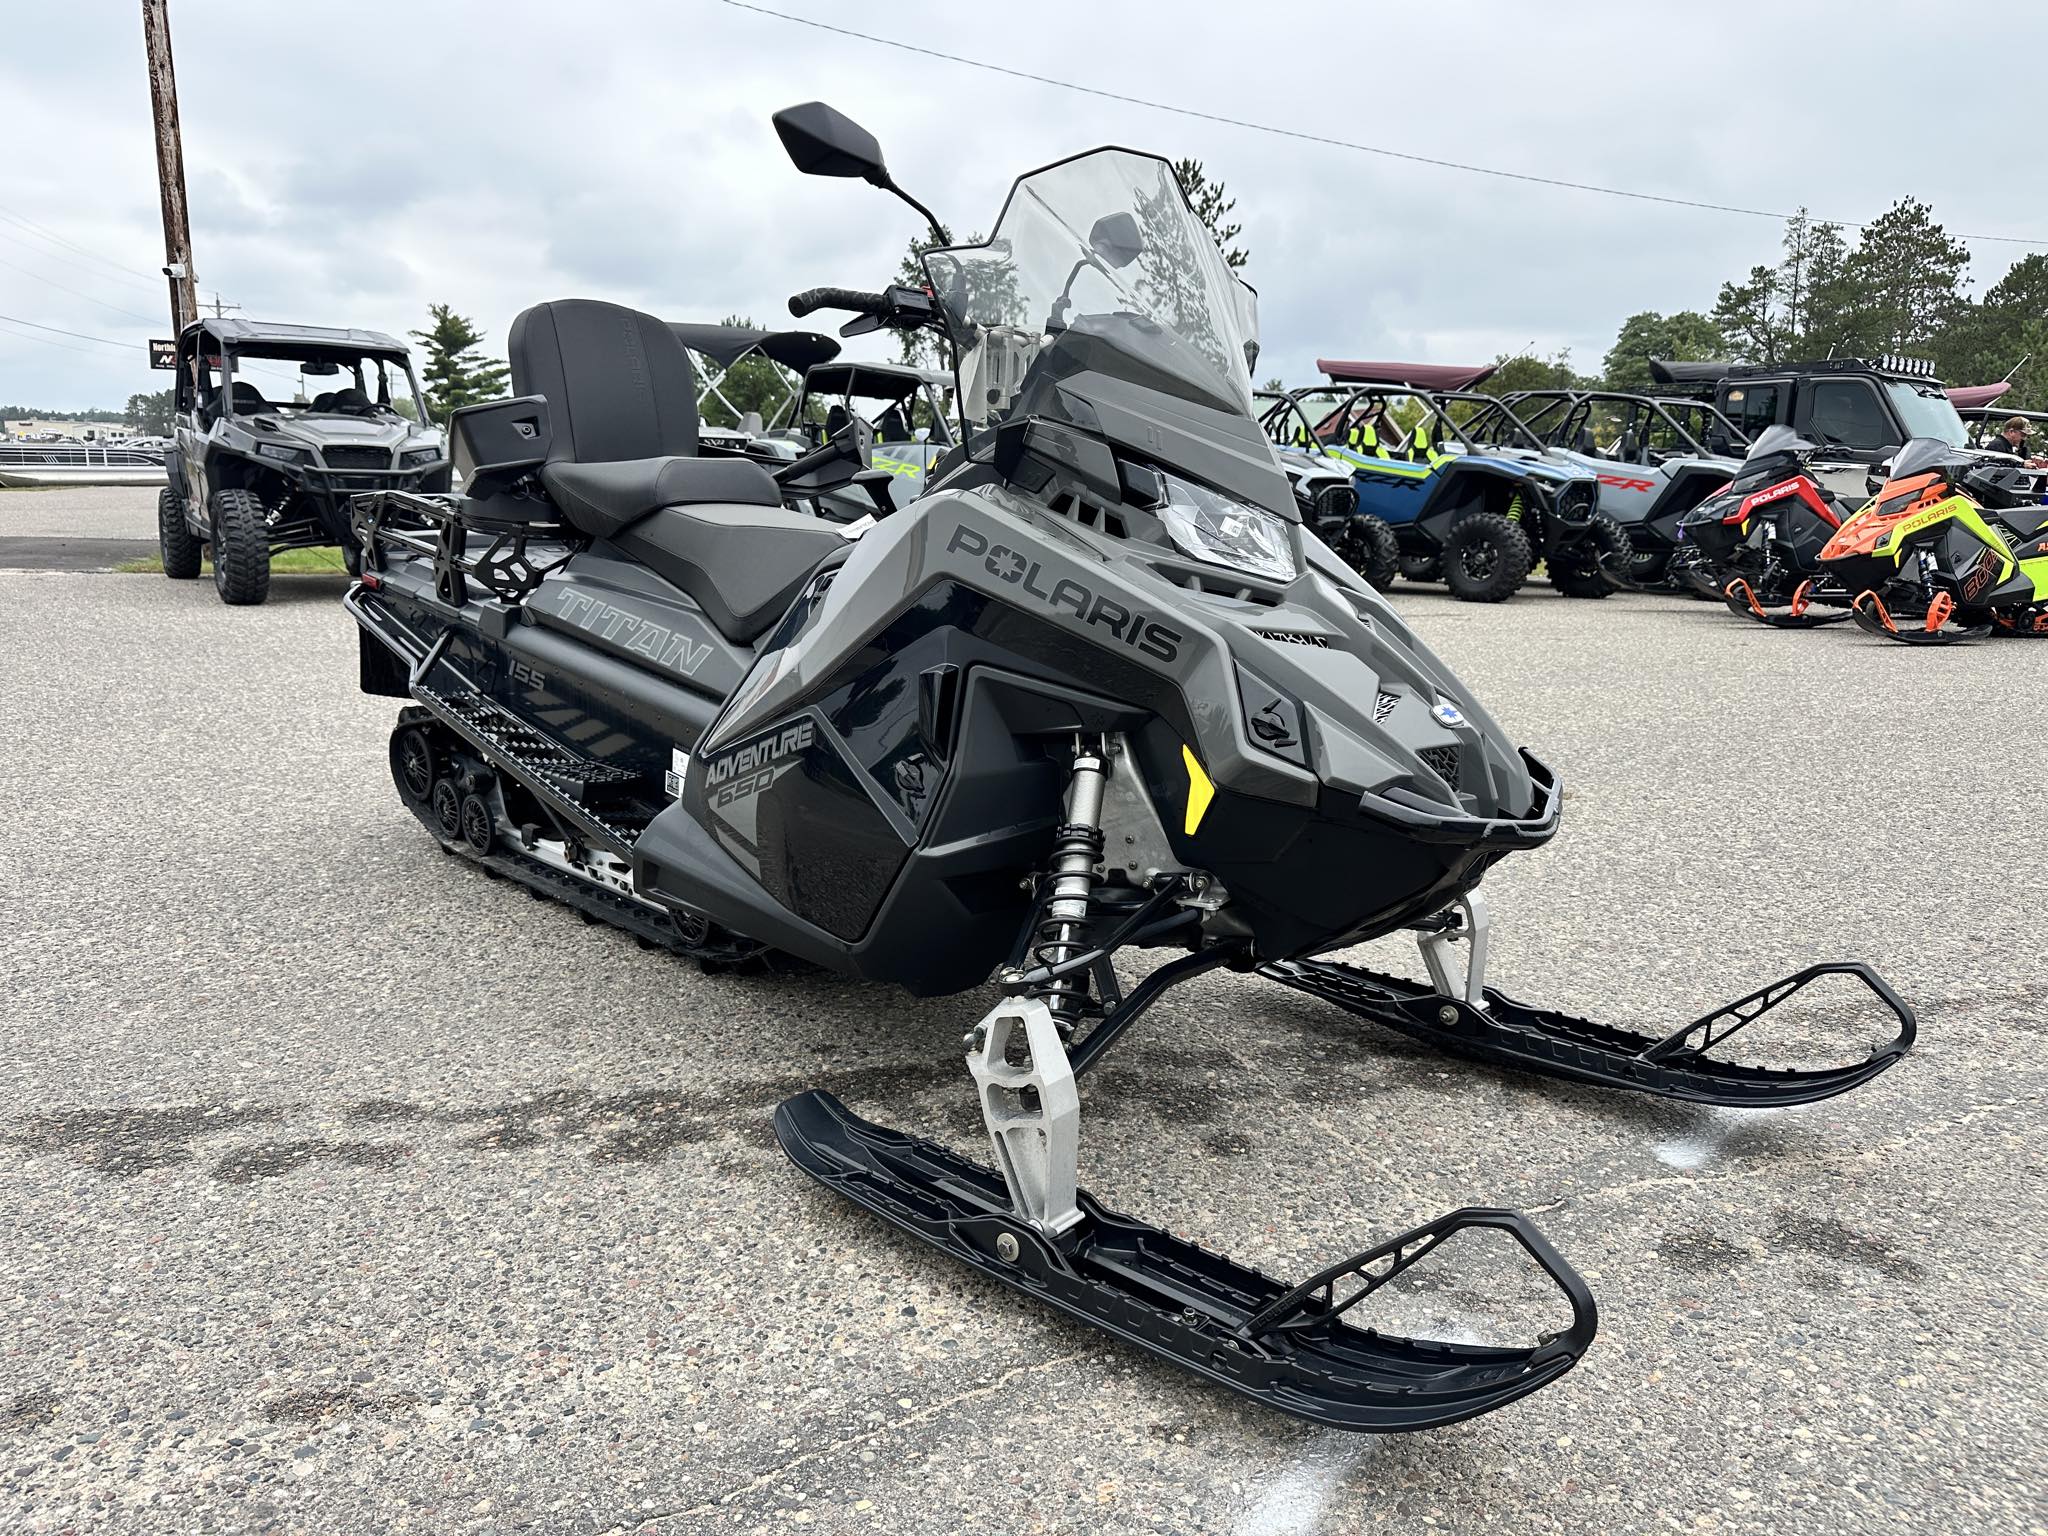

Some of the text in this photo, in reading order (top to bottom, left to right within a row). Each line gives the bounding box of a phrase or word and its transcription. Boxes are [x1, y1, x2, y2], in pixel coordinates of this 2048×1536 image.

[872, 456, 921, 478] ZR
[1596, 474, 1656, 493] ZR
[1750, 482, 1800, 506] POLARIS
[1903, 504, 1957, 532] POLARIS
[946, 523, 1183, 663] POLARIS
[557, 587, 714, 677] TITAN
[508, 659, 546, 692] 155
[705, 721, 814, 789] ADVENTURE
[717, 766, 776, 808] 650
